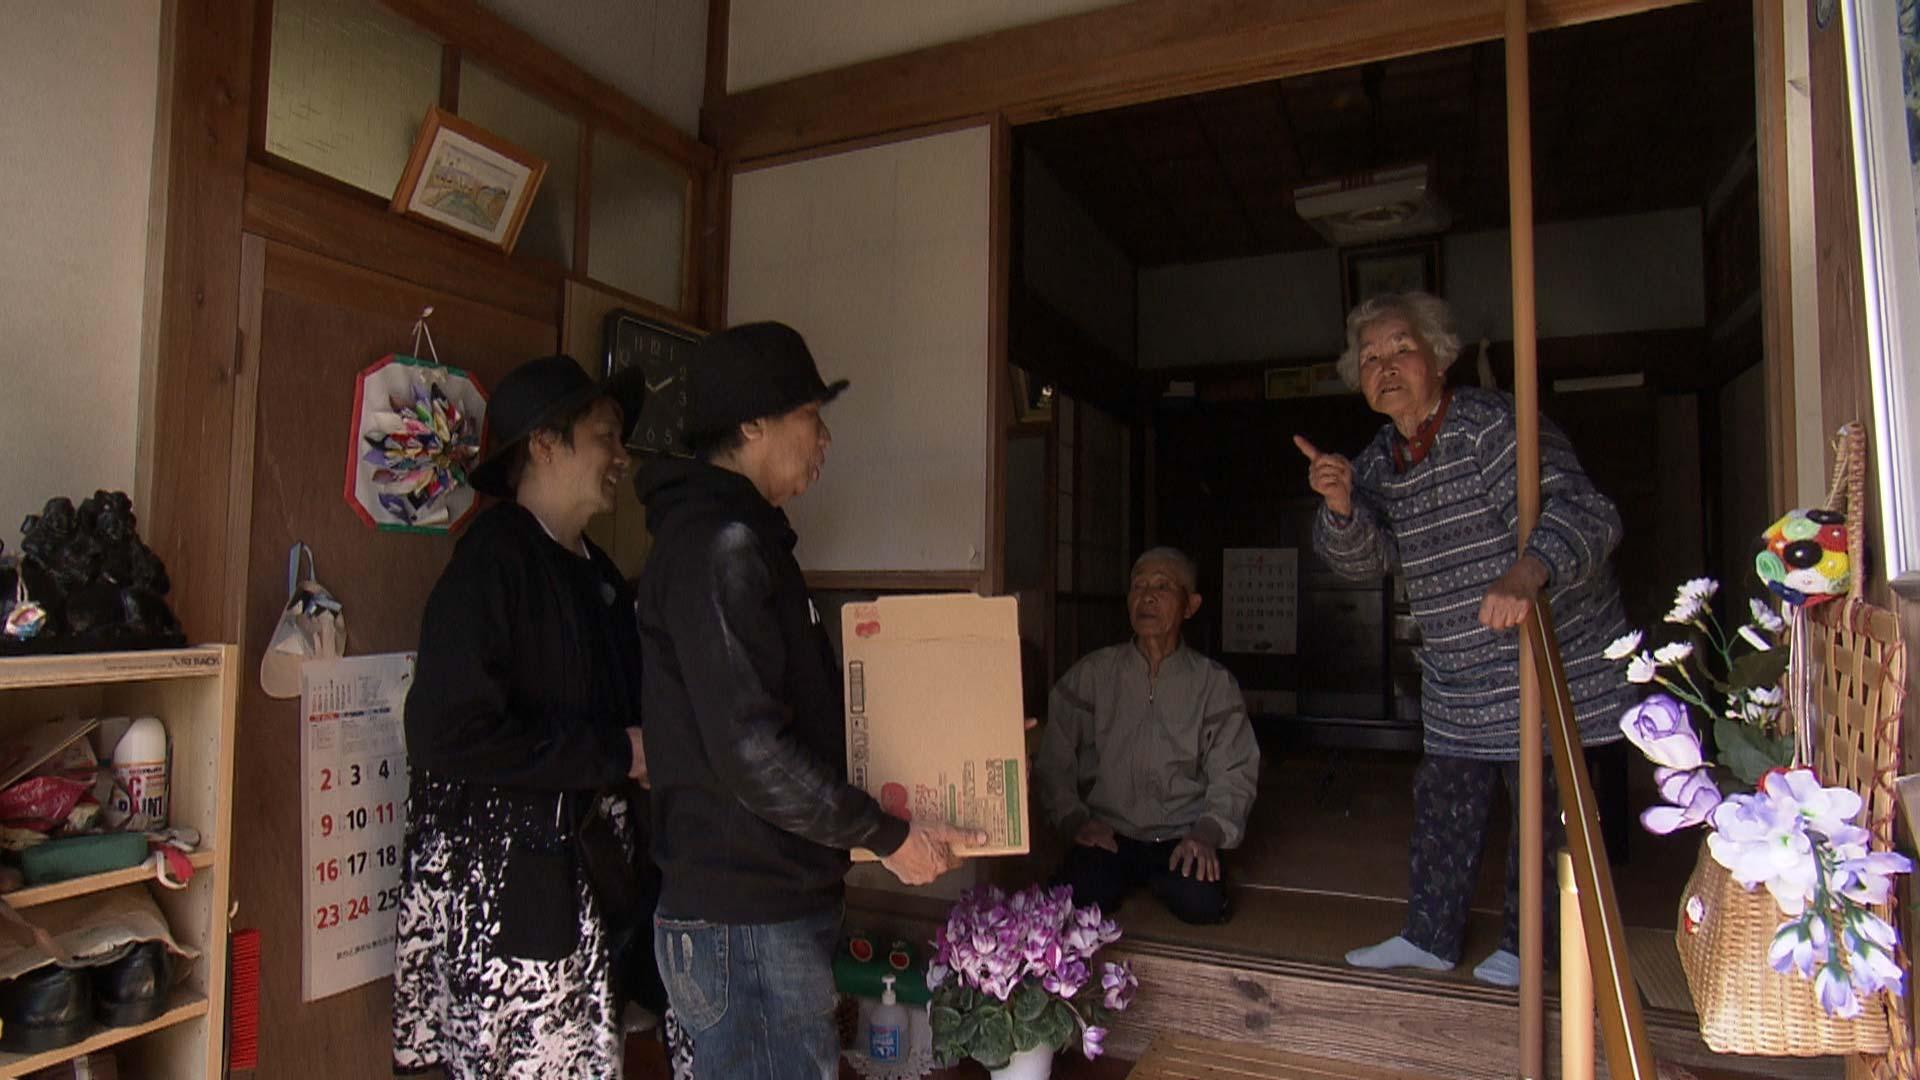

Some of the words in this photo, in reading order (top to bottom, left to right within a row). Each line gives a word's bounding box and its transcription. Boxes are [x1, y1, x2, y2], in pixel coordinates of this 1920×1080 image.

[320, 767, 332, 791] 2
[350, 763, 361, 786] 3
[378, 759, 390, 780] 4
[320, 813, 333, 837] 9
[346, 807, 368, 830] 10
[375, 801, 394, 824] 11
[316, 857, 339, 883] 16
[347, 850, 368, 876] 17
[375, 844, 397, 867] 18
[316, 903, 340, 929] 23
[347, 895, 370, 921] 24
[377, 887, 398, 912] 25
